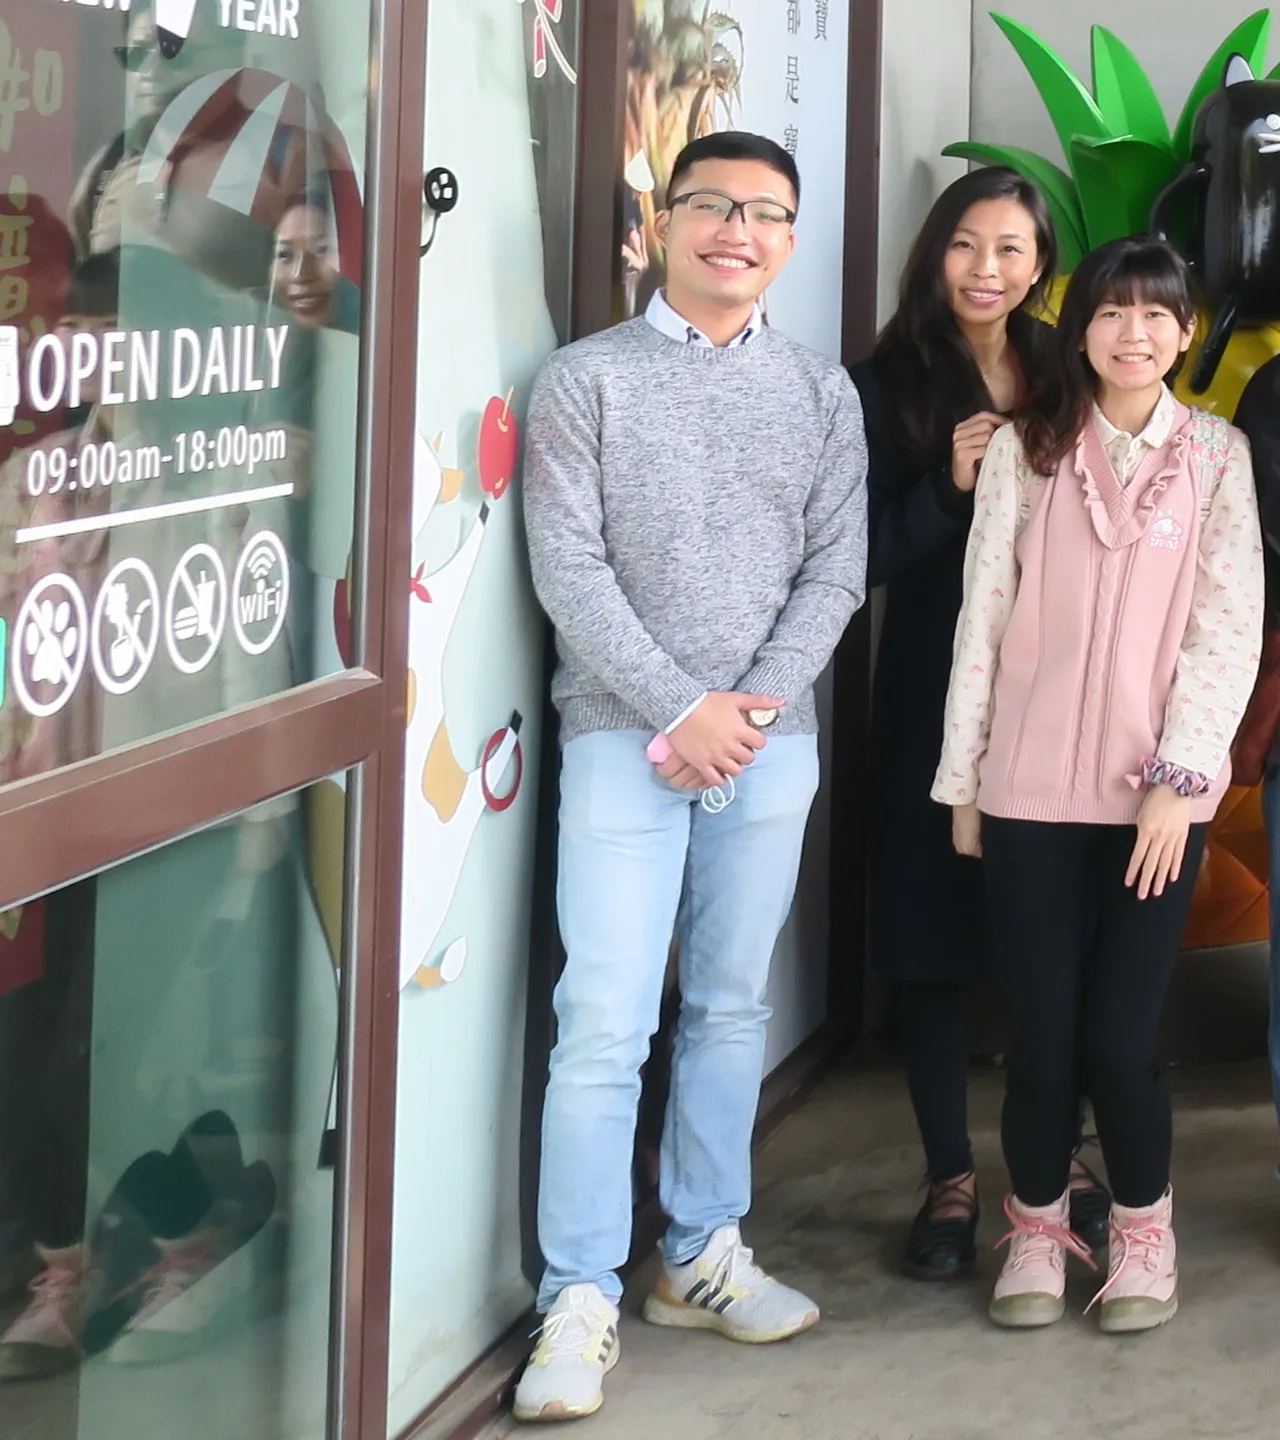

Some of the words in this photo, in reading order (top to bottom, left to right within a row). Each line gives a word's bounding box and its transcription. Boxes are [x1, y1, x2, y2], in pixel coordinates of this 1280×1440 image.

[29, 329, 160, 412] OPEN
[171, 324, 289, 399] DAILY
[27, 424, 287, 497] 09:00am-18:00pm
